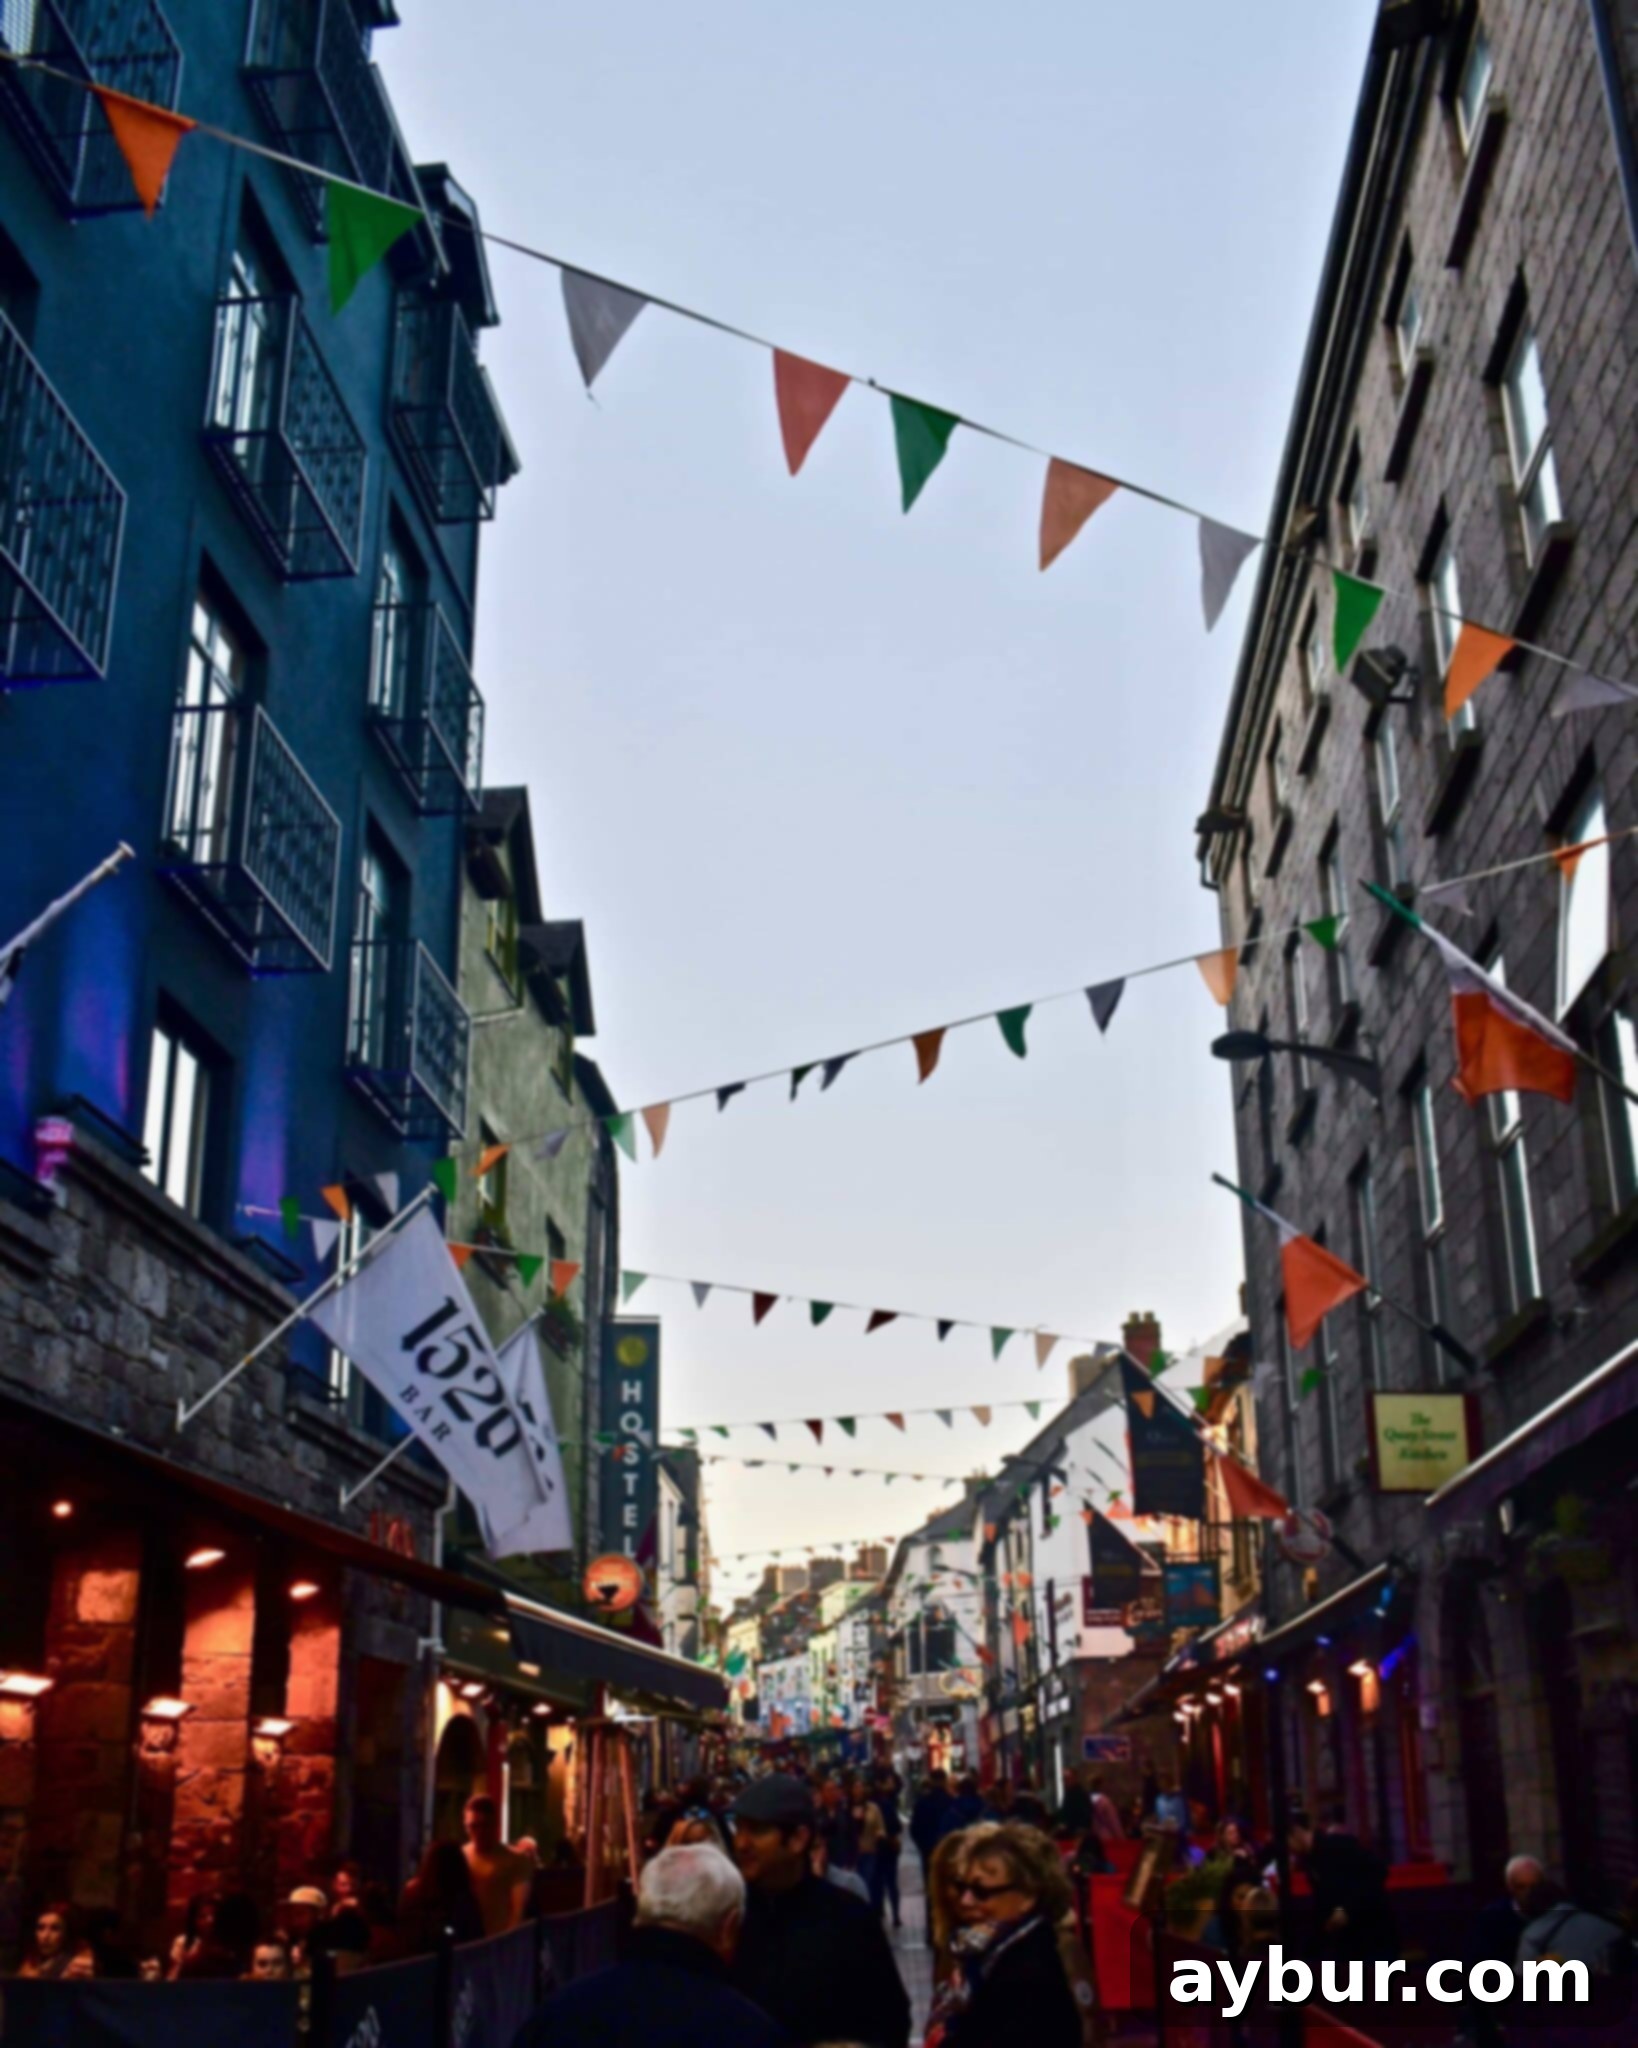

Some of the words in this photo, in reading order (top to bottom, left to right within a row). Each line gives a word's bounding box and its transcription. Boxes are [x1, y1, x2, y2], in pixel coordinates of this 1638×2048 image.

[400, 1384, 452, 1442] BAR
[401, 1296, 523, 1458] 1520
[620, 1380, 643, 1559] HOSTEL
